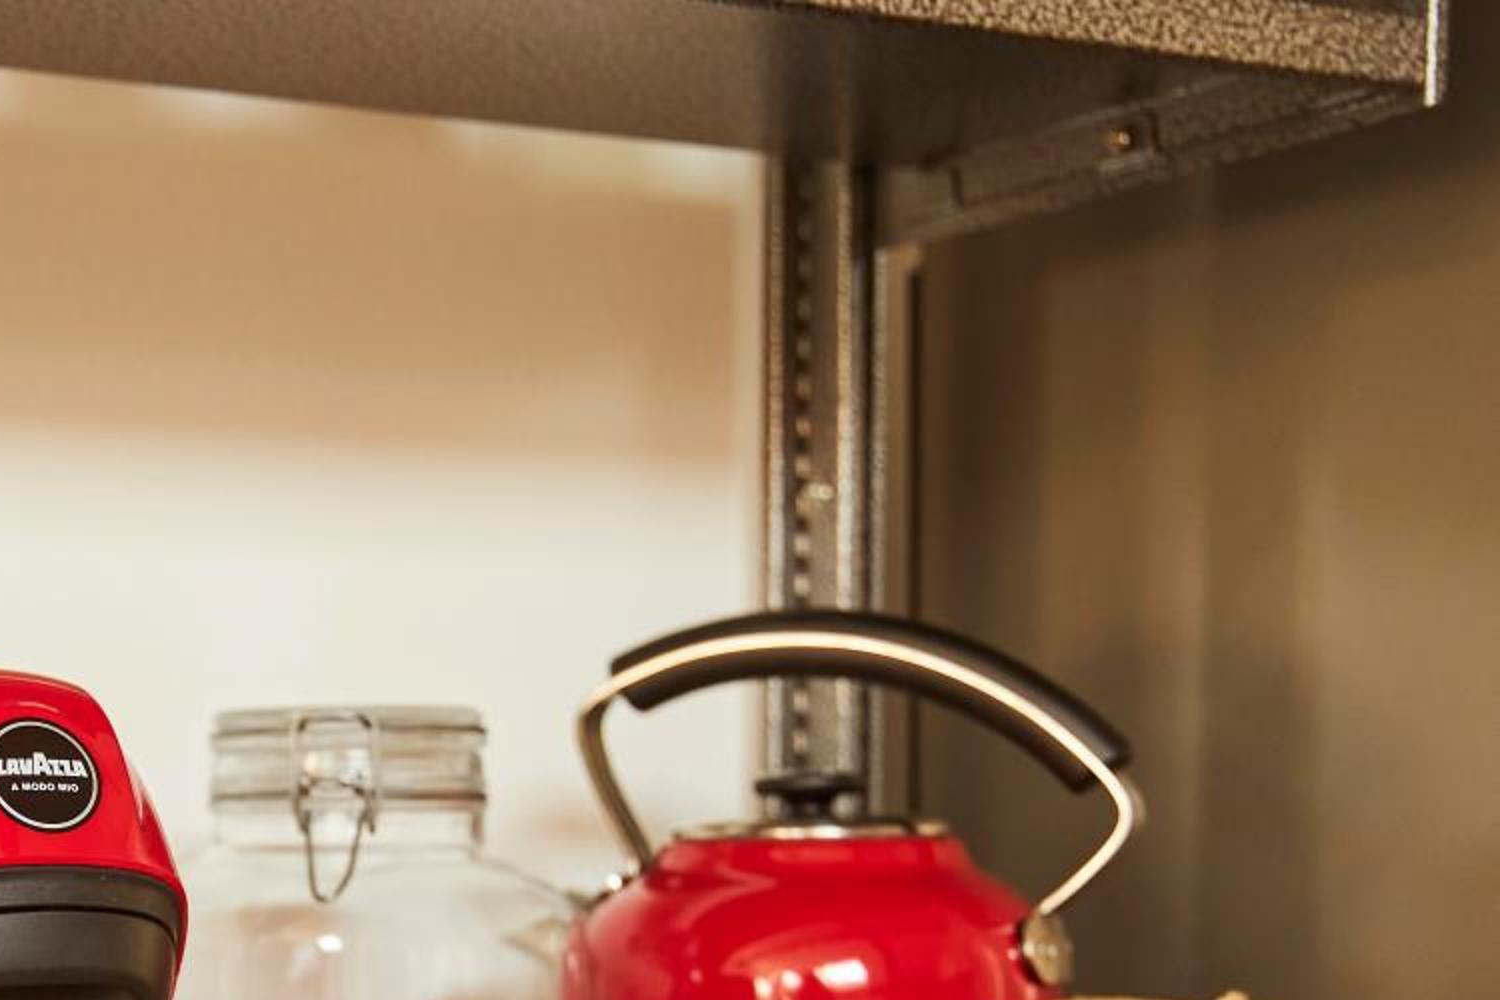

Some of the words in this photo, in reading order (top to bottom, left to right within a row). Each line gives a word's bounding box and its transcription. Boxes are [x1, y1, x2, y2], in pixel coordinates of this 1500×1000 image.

[11, 783, 19, 791] A
[22, 783, 55, 791] MODO
[58, 784, 79, 792] MIO
